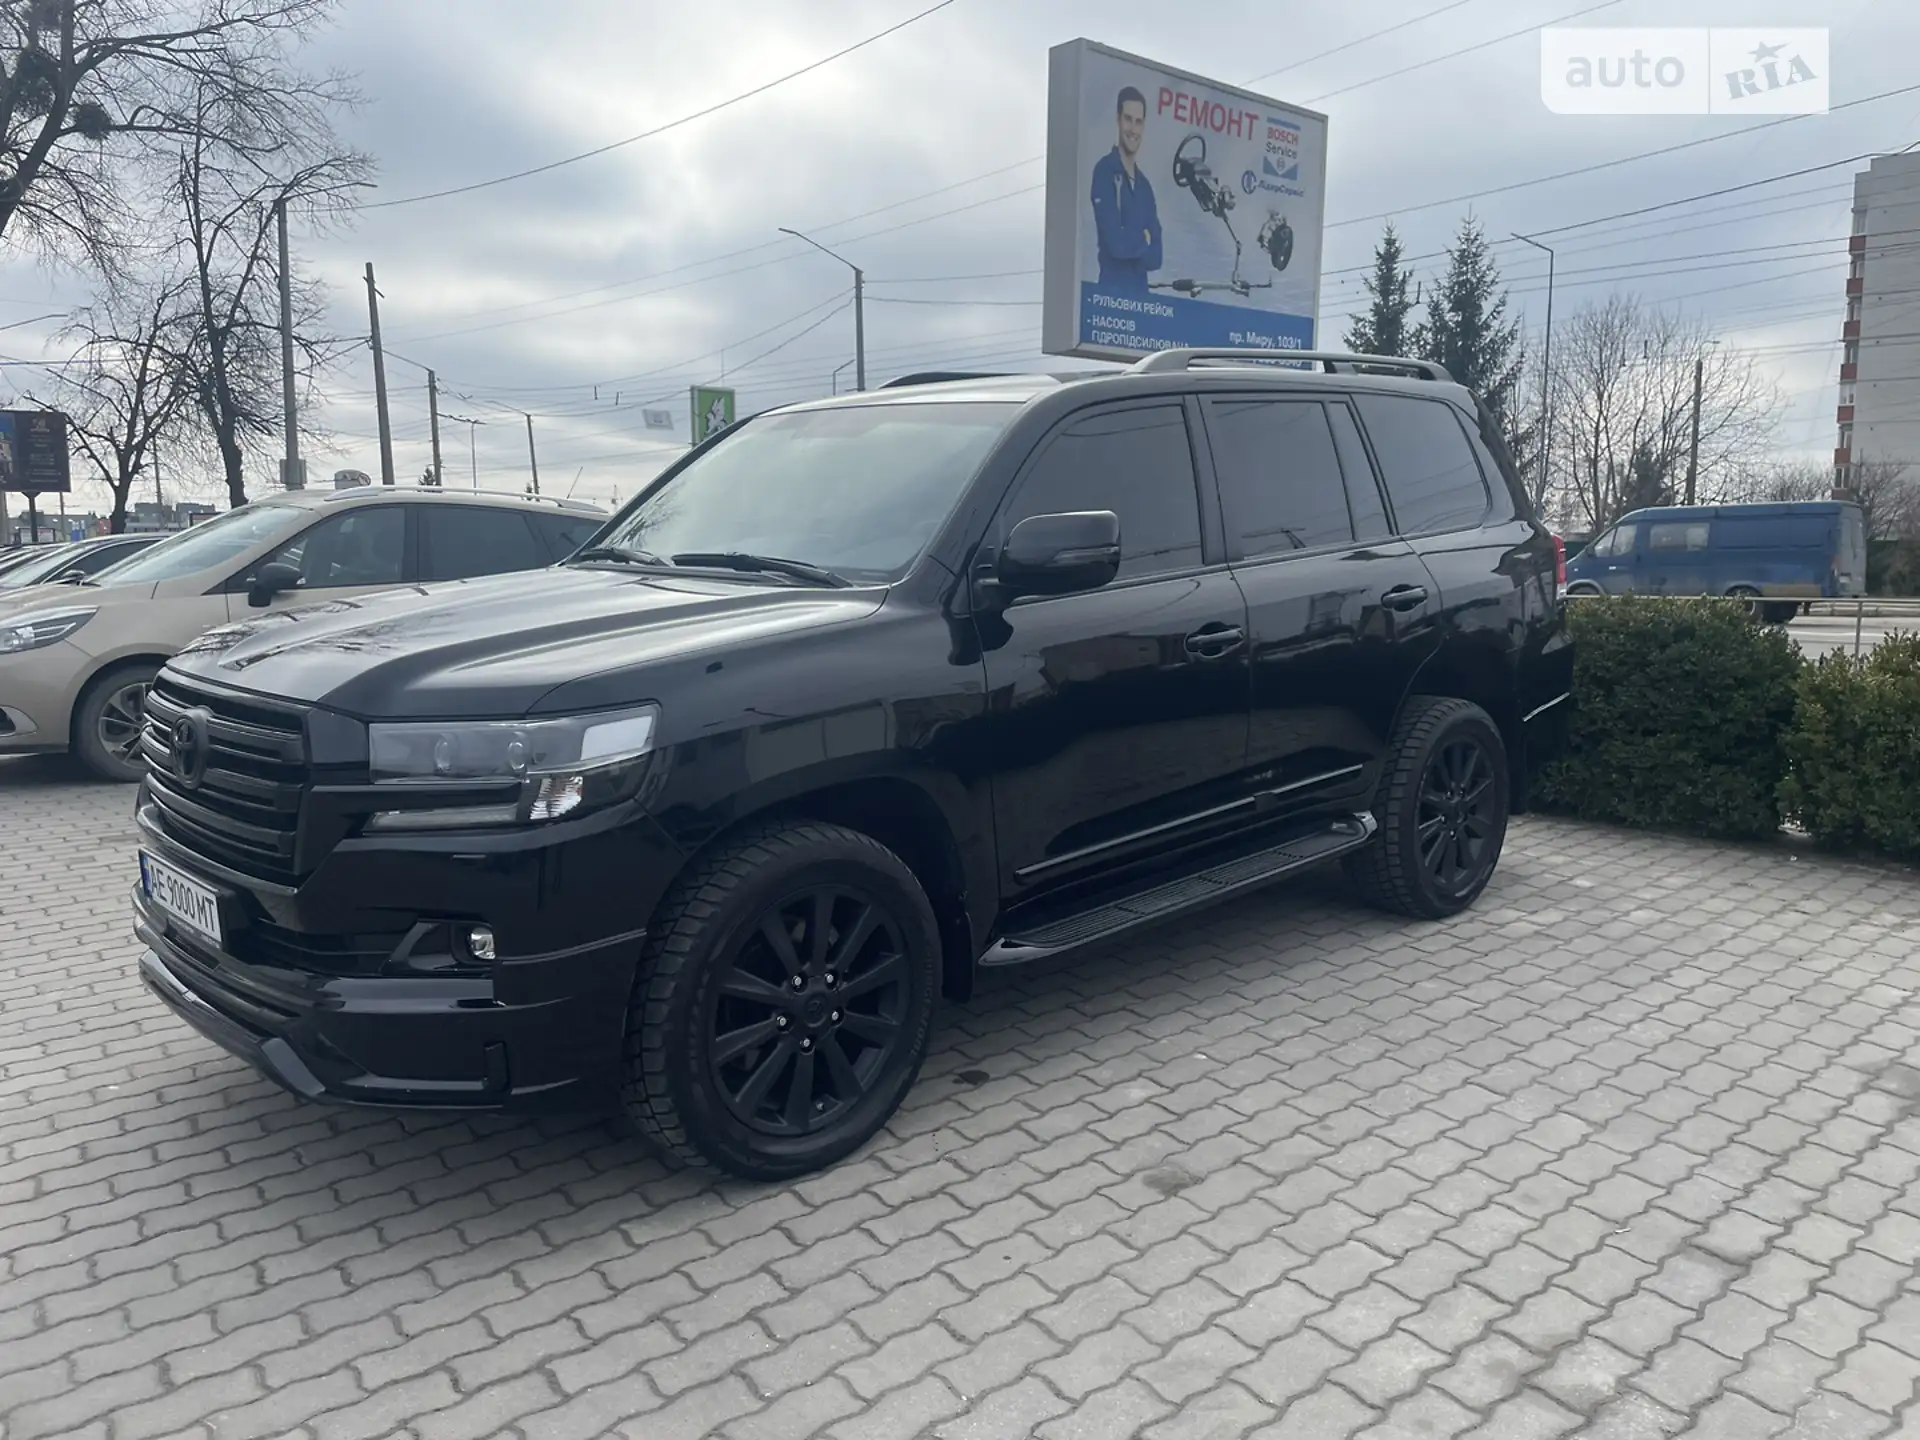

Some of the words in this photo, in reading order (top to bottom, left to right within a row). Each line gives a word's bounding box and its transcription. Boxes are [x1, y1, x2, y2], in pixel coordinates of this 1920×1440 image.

[1158, 87, 1259, 141] РЕМОНТ
[1267, 127, 1299, 147] BOSCH
[1265, 141, 1298, 160] Service
[1093, 294, 1143, 312] РУЛЬОВИХ
[1143, 302, 1174, 318] РЕЙОК
[1092, 314, 1136, 331] НАСОСІВ
[1278, 335, 1302, 350] 103/1
[150, 864, 168, 902] AE
[167, 875, 195, 919] 9000
[195, 892, 215, 932] MT
